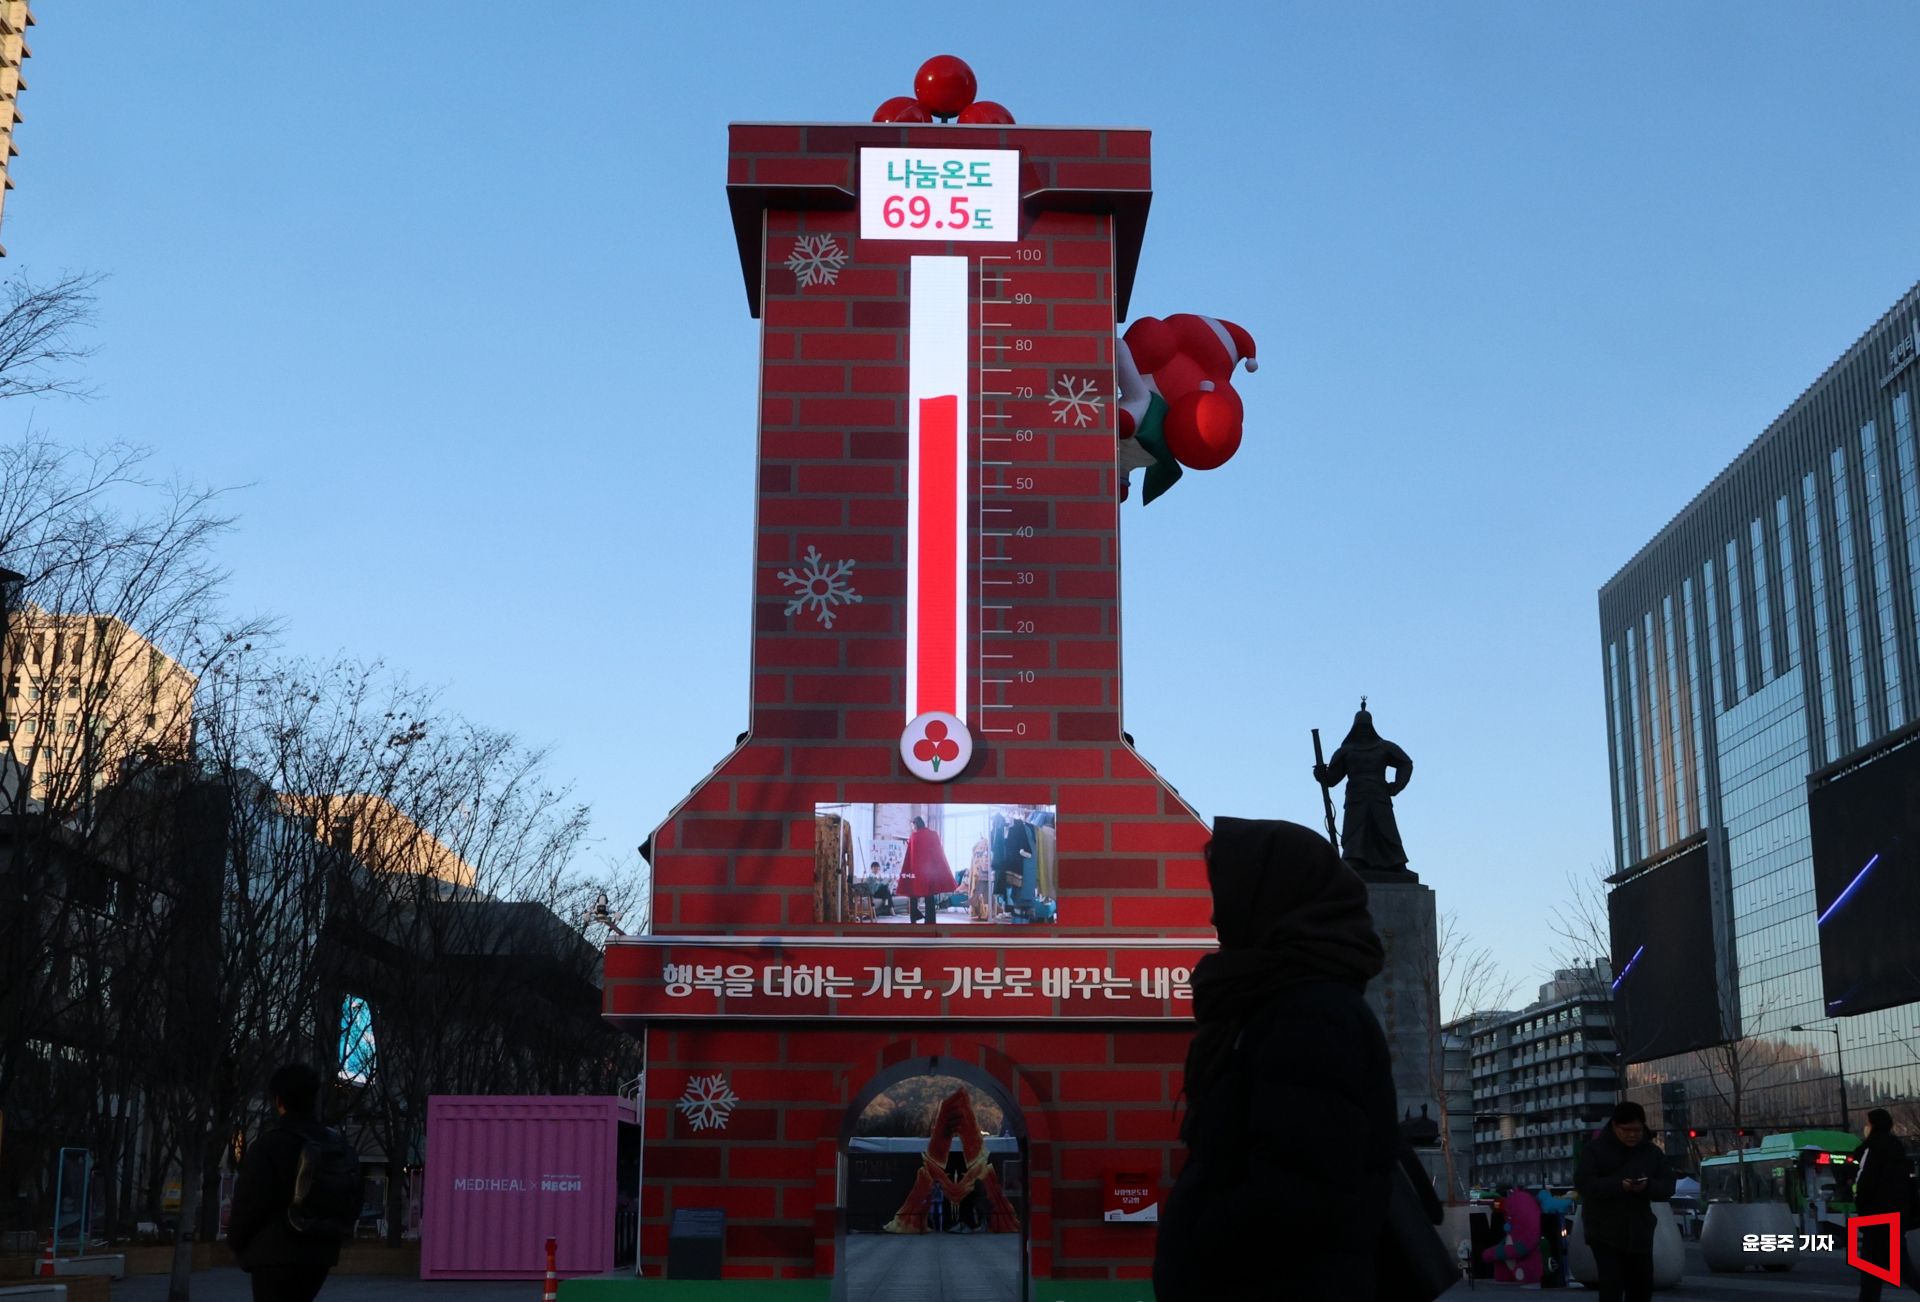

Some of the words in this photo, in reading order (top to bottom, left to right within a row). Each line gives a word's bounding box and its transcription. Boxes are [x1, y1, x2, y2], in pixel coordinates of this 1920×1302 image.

[887, 158, 993, 190] 나눔온도
[882, 194, 994, 230] 69.5도
[1015, 249, 1042, 261] 100
[1015, 293, 1032, 305] 90
[1015, 339, 1033, 351] 80
[1016, 386, 1033, 399] 70
[1015, 429, 1033, 442] 60
[1016, 477, 1034, 490] 50
[1016, 526, 1034, 538] 40
[1016, 572, 1034, 584] 30
[1016, 621, 1035, 633] 20
[1017, 670, 1035, 683] 10
[1016, 722, 1026, 735] 0
[662, 964, 755, 997] 행복을
[763, 964, 854, 998] 더하는
[862, 966, 933, 1000] 기부,
[941, 966, 1034, 999] 기부로
[1041, 966, 1133, 1000] 바꾸는
[1140, 966, 1195, 1000] 내일
[454, 1178, 527, 1192] MEDIHEAL
